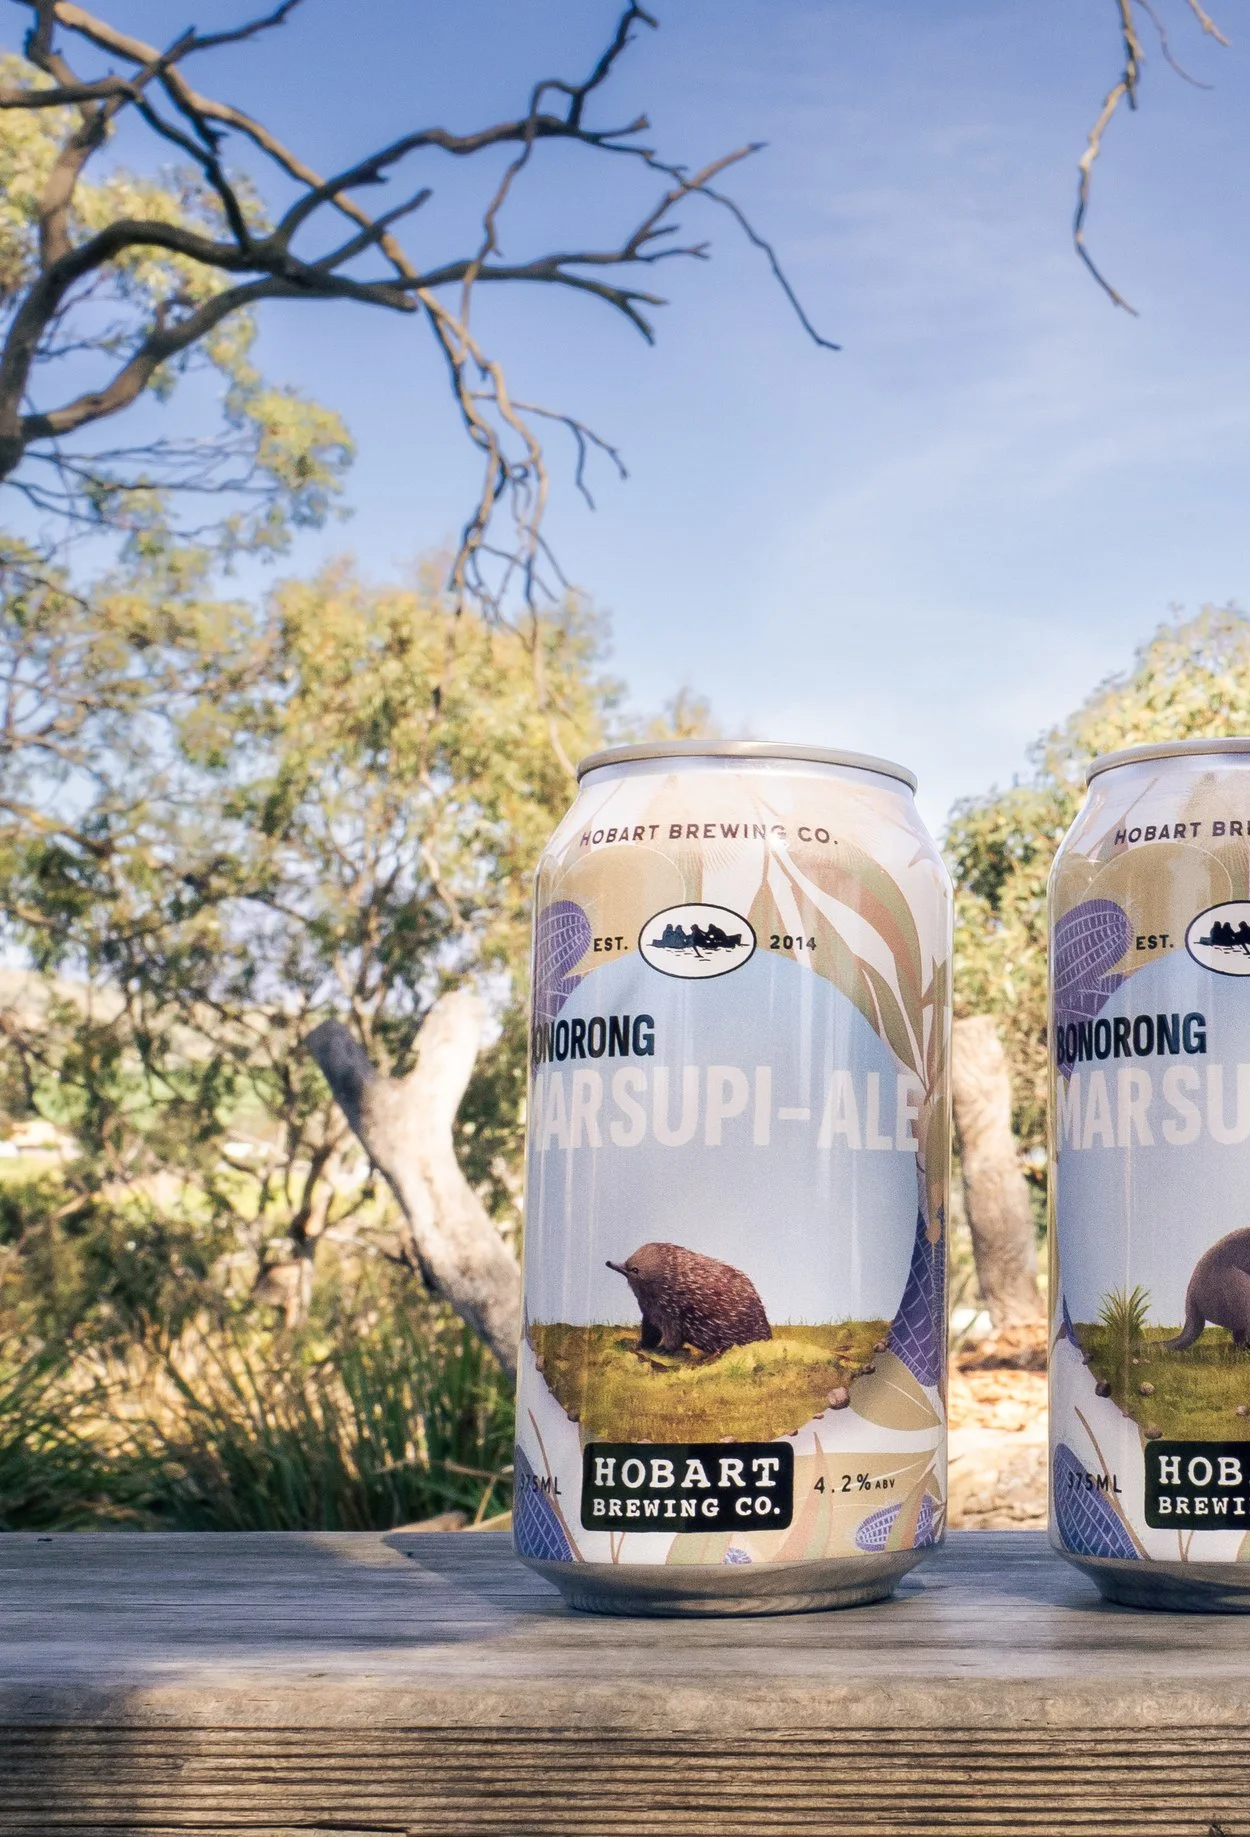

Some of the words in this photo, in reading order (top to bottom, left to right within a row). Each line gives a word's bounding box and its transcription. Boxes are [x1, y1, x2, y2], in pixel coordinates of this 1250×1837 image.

[580, 824, 660, 847] HOBART
[669, 823, 787, 841] BREWING
[797, 826, 839, 845] CO.
[1114, 822, 1202, 845] HOBART
[593, 936, 629, 952] EST.
[770, 935, 817, 951] 2014
[1135, 934, 1174, 950] EST.
[532, 1013, 656, 1064] ONORONG
[1056, 1011, 1208, 1066] BONORONG
[594, 1457, 781, 1489] HOBART
[813, 1473, 871, 1494] 4.2%
[1068, 1472, 1123, 1493] 375ML
[592, 1497, 720, 1518] BREWING
[734, 1496, 781, 1516] CO.
